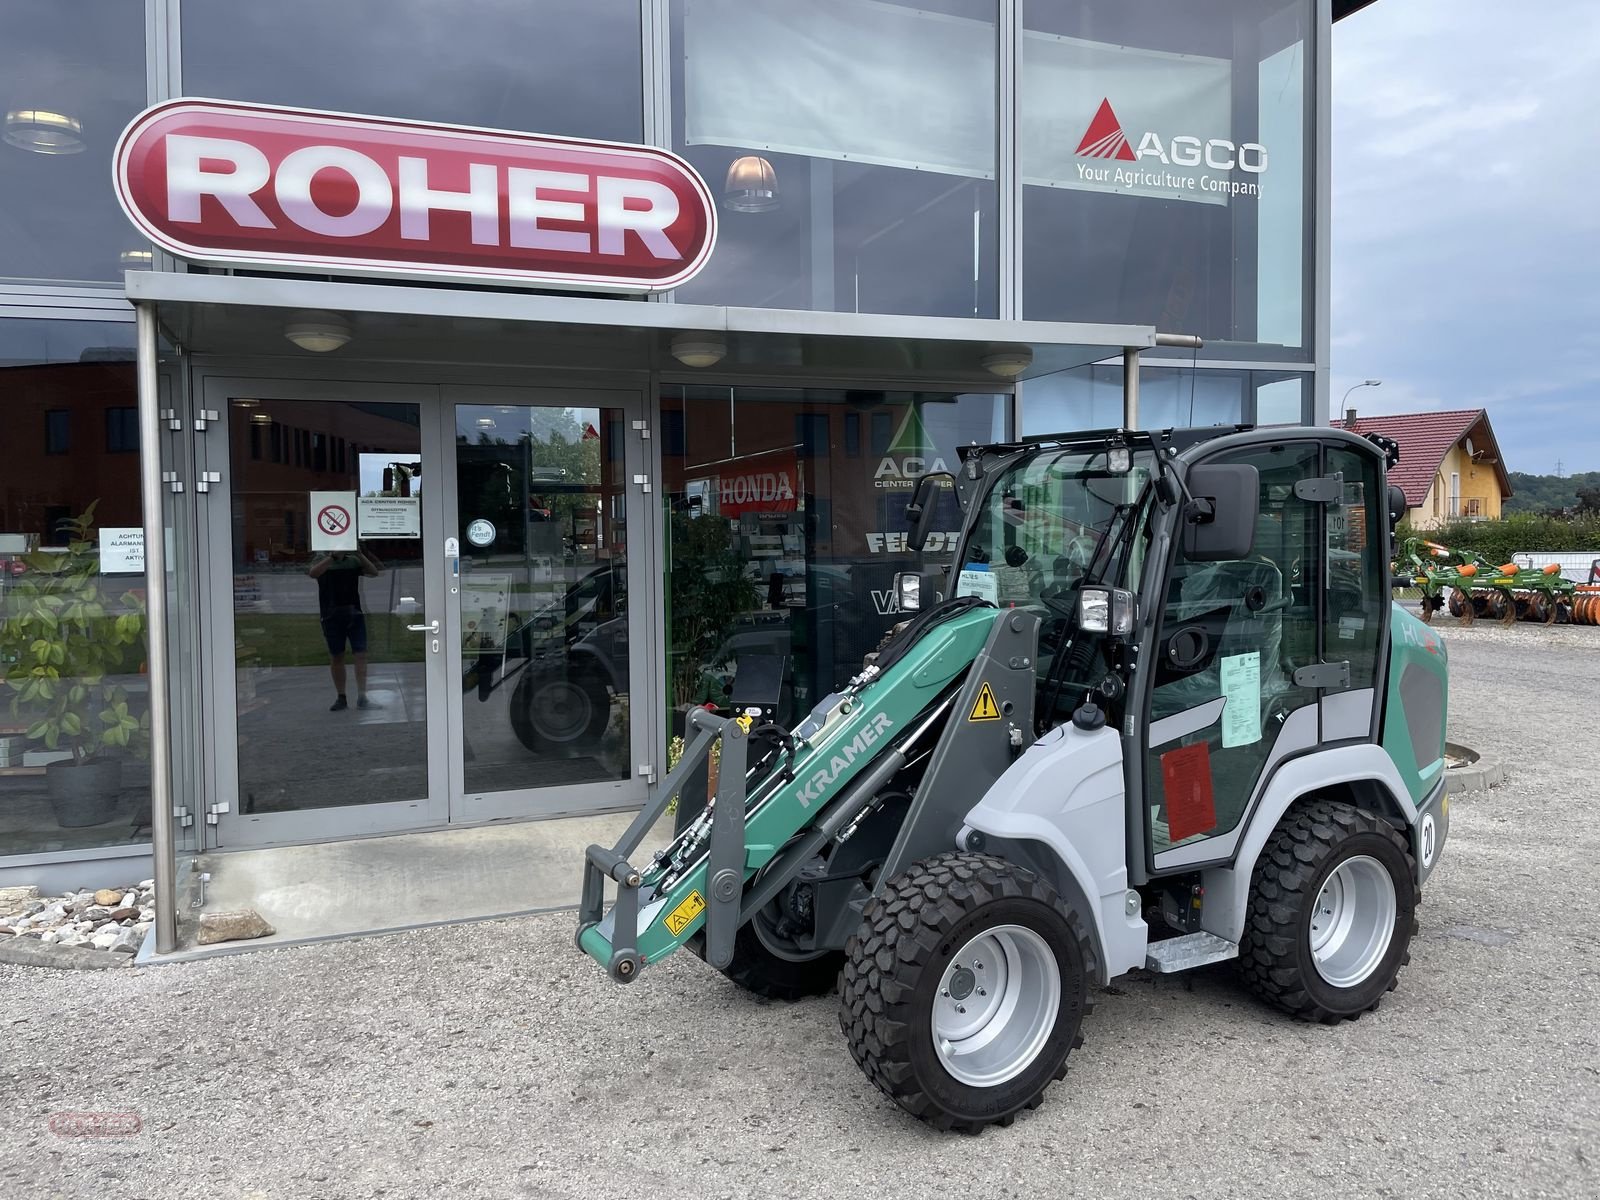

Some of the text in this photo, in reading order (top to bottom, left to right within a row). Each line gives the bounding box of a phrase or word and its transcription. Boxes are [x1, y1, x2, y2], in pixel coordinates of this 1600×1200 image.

[1136, 132, 1268, 173] AGCO
[166, 134, 684, 260] ROHER
[1077, 163, 1264, 199] Your Agriculture Company
[874, 457, 950, 479] ACA
[721, 471, 795, 504] HONDA
[796, 712, 893, 808] KRAMER
[1425, 822, 1433, 860] 20
